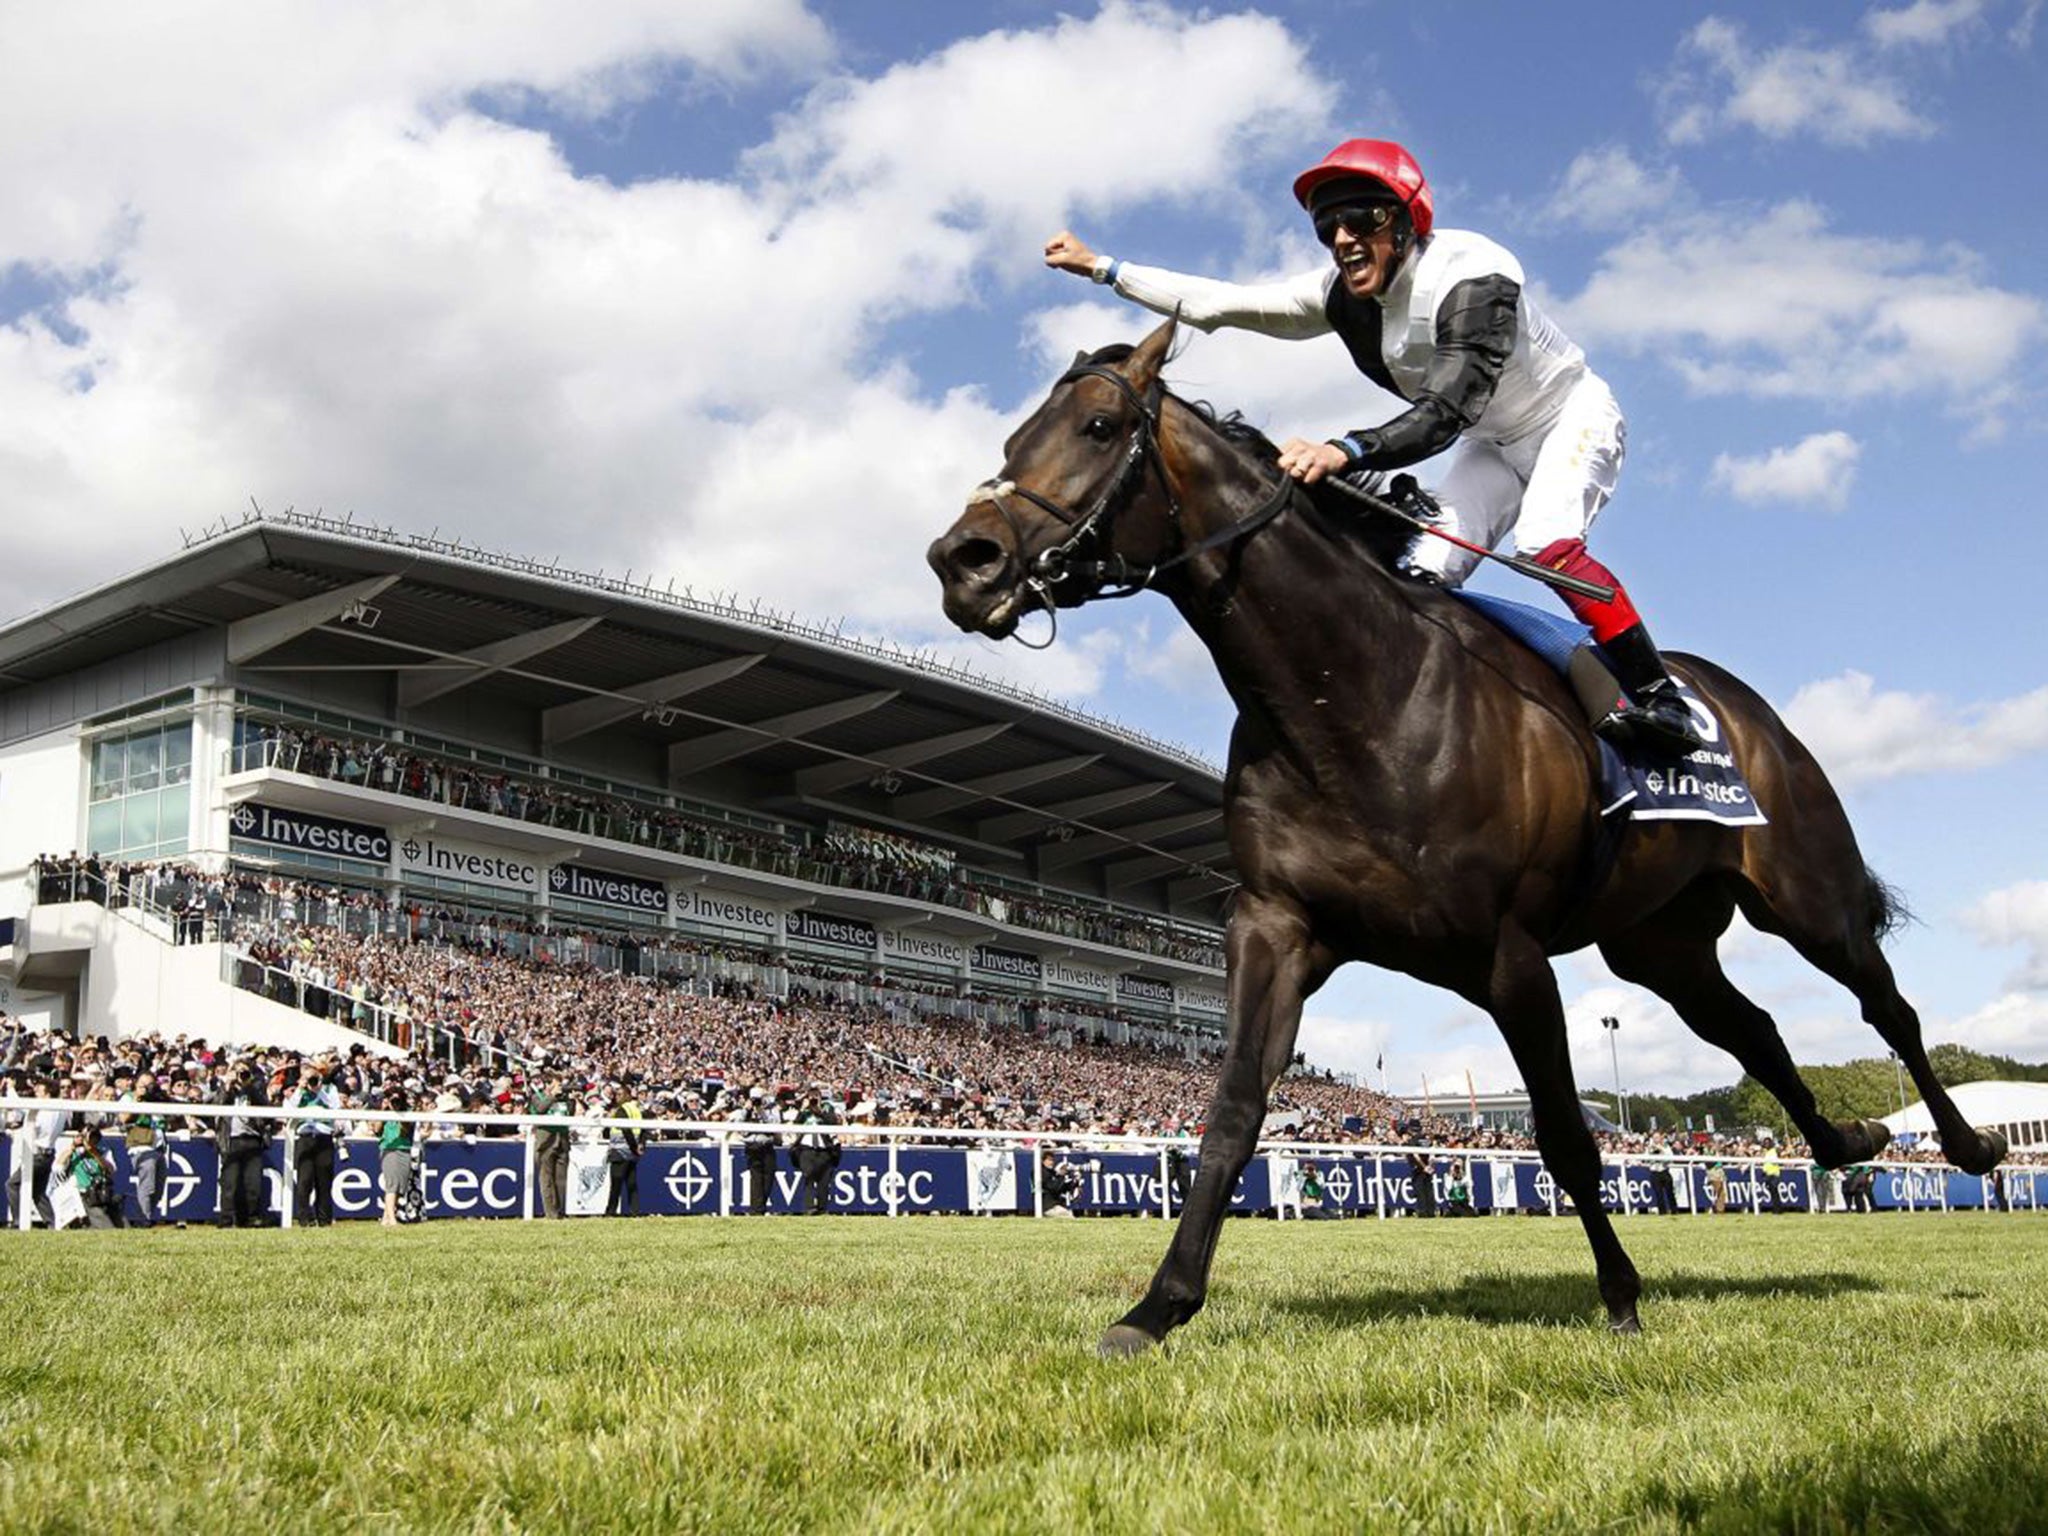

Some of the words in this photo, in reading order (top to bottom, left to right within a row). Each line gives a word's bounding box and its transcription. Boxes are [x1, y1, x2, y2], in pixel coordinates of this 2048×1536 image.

[261, 808, 387, 858] Investec
[426, 841, 534, 884] Investec
[571, 868, 666, 908] Investec
[693, 892, 774, 928] Investec
[802, 913, 875, 946] Investec
[896, 931, 961, 962] Investec
[981, 950, 1039, 976] Investec
[1056, 963, 1108, 990] Investec
[1124, 975, 1172, 1000] Investec
